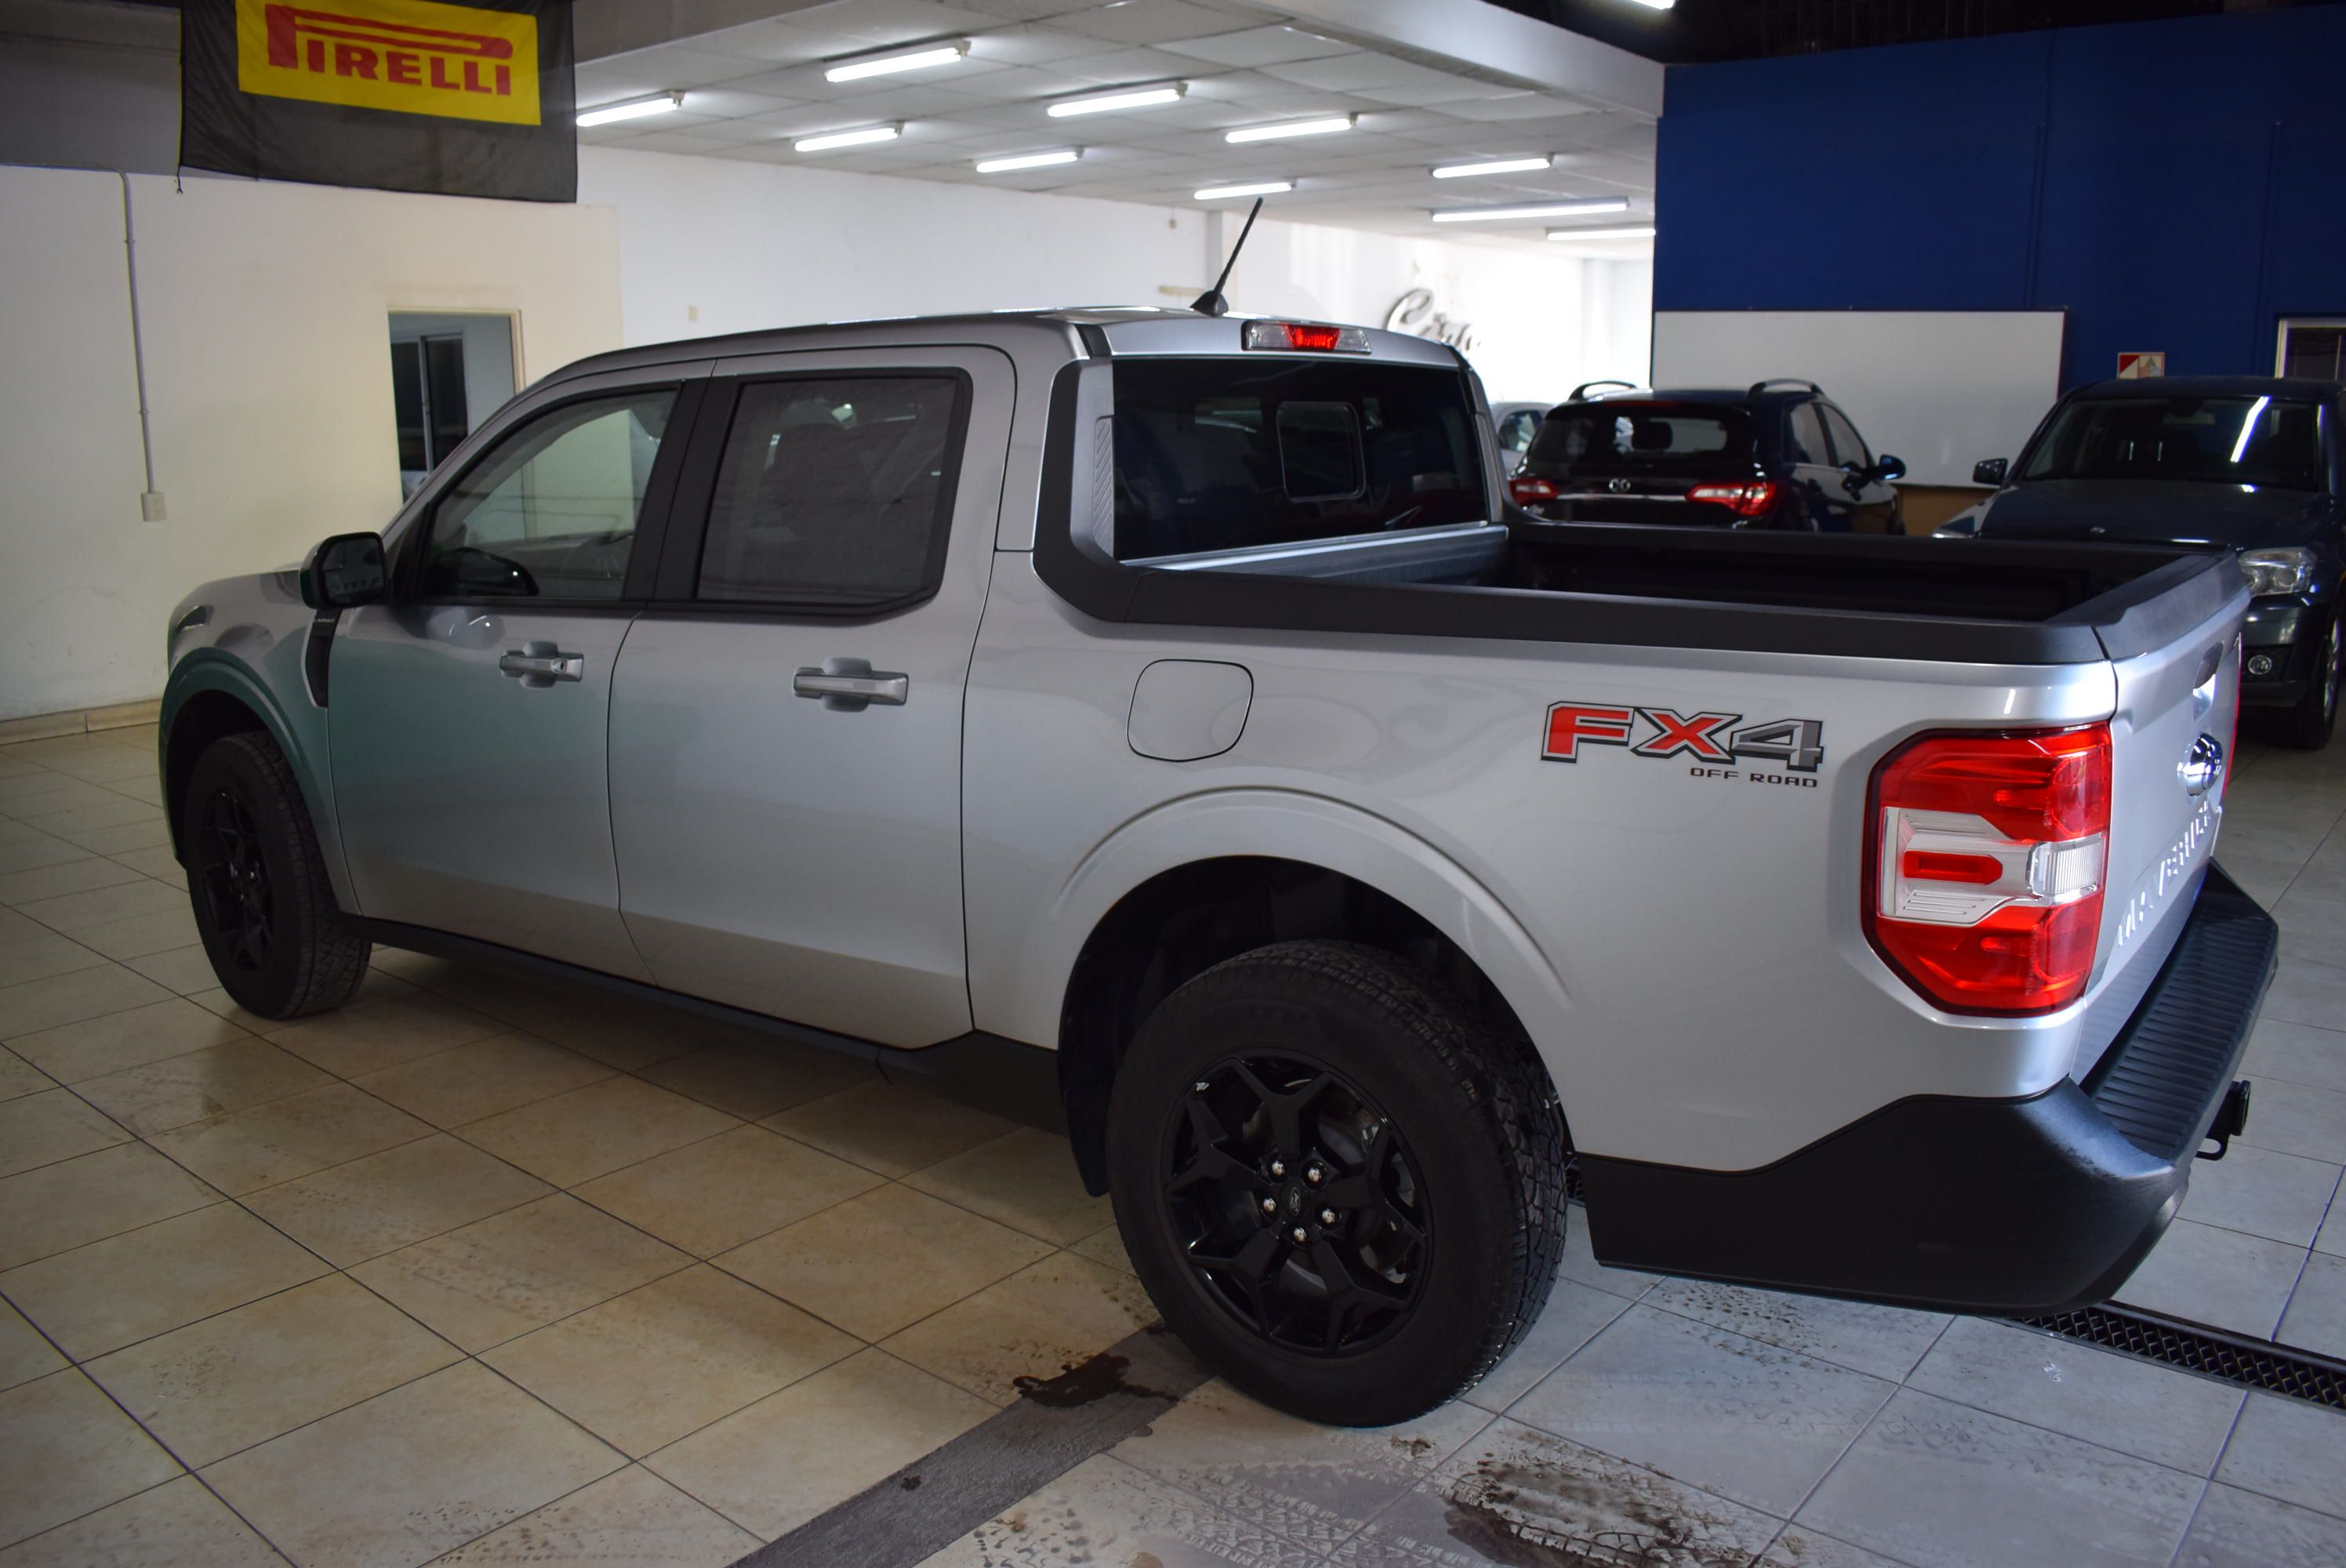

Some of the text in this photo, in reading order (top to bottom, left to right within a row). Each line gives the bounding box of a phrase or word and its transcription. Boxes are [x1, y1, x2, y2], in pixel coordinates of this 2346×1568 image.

[264, 3, 514, 96] PIRELLI
[1541, 701, 1823, 773] FX4
[1690, 767, 1818, 789] OFF ROAD
